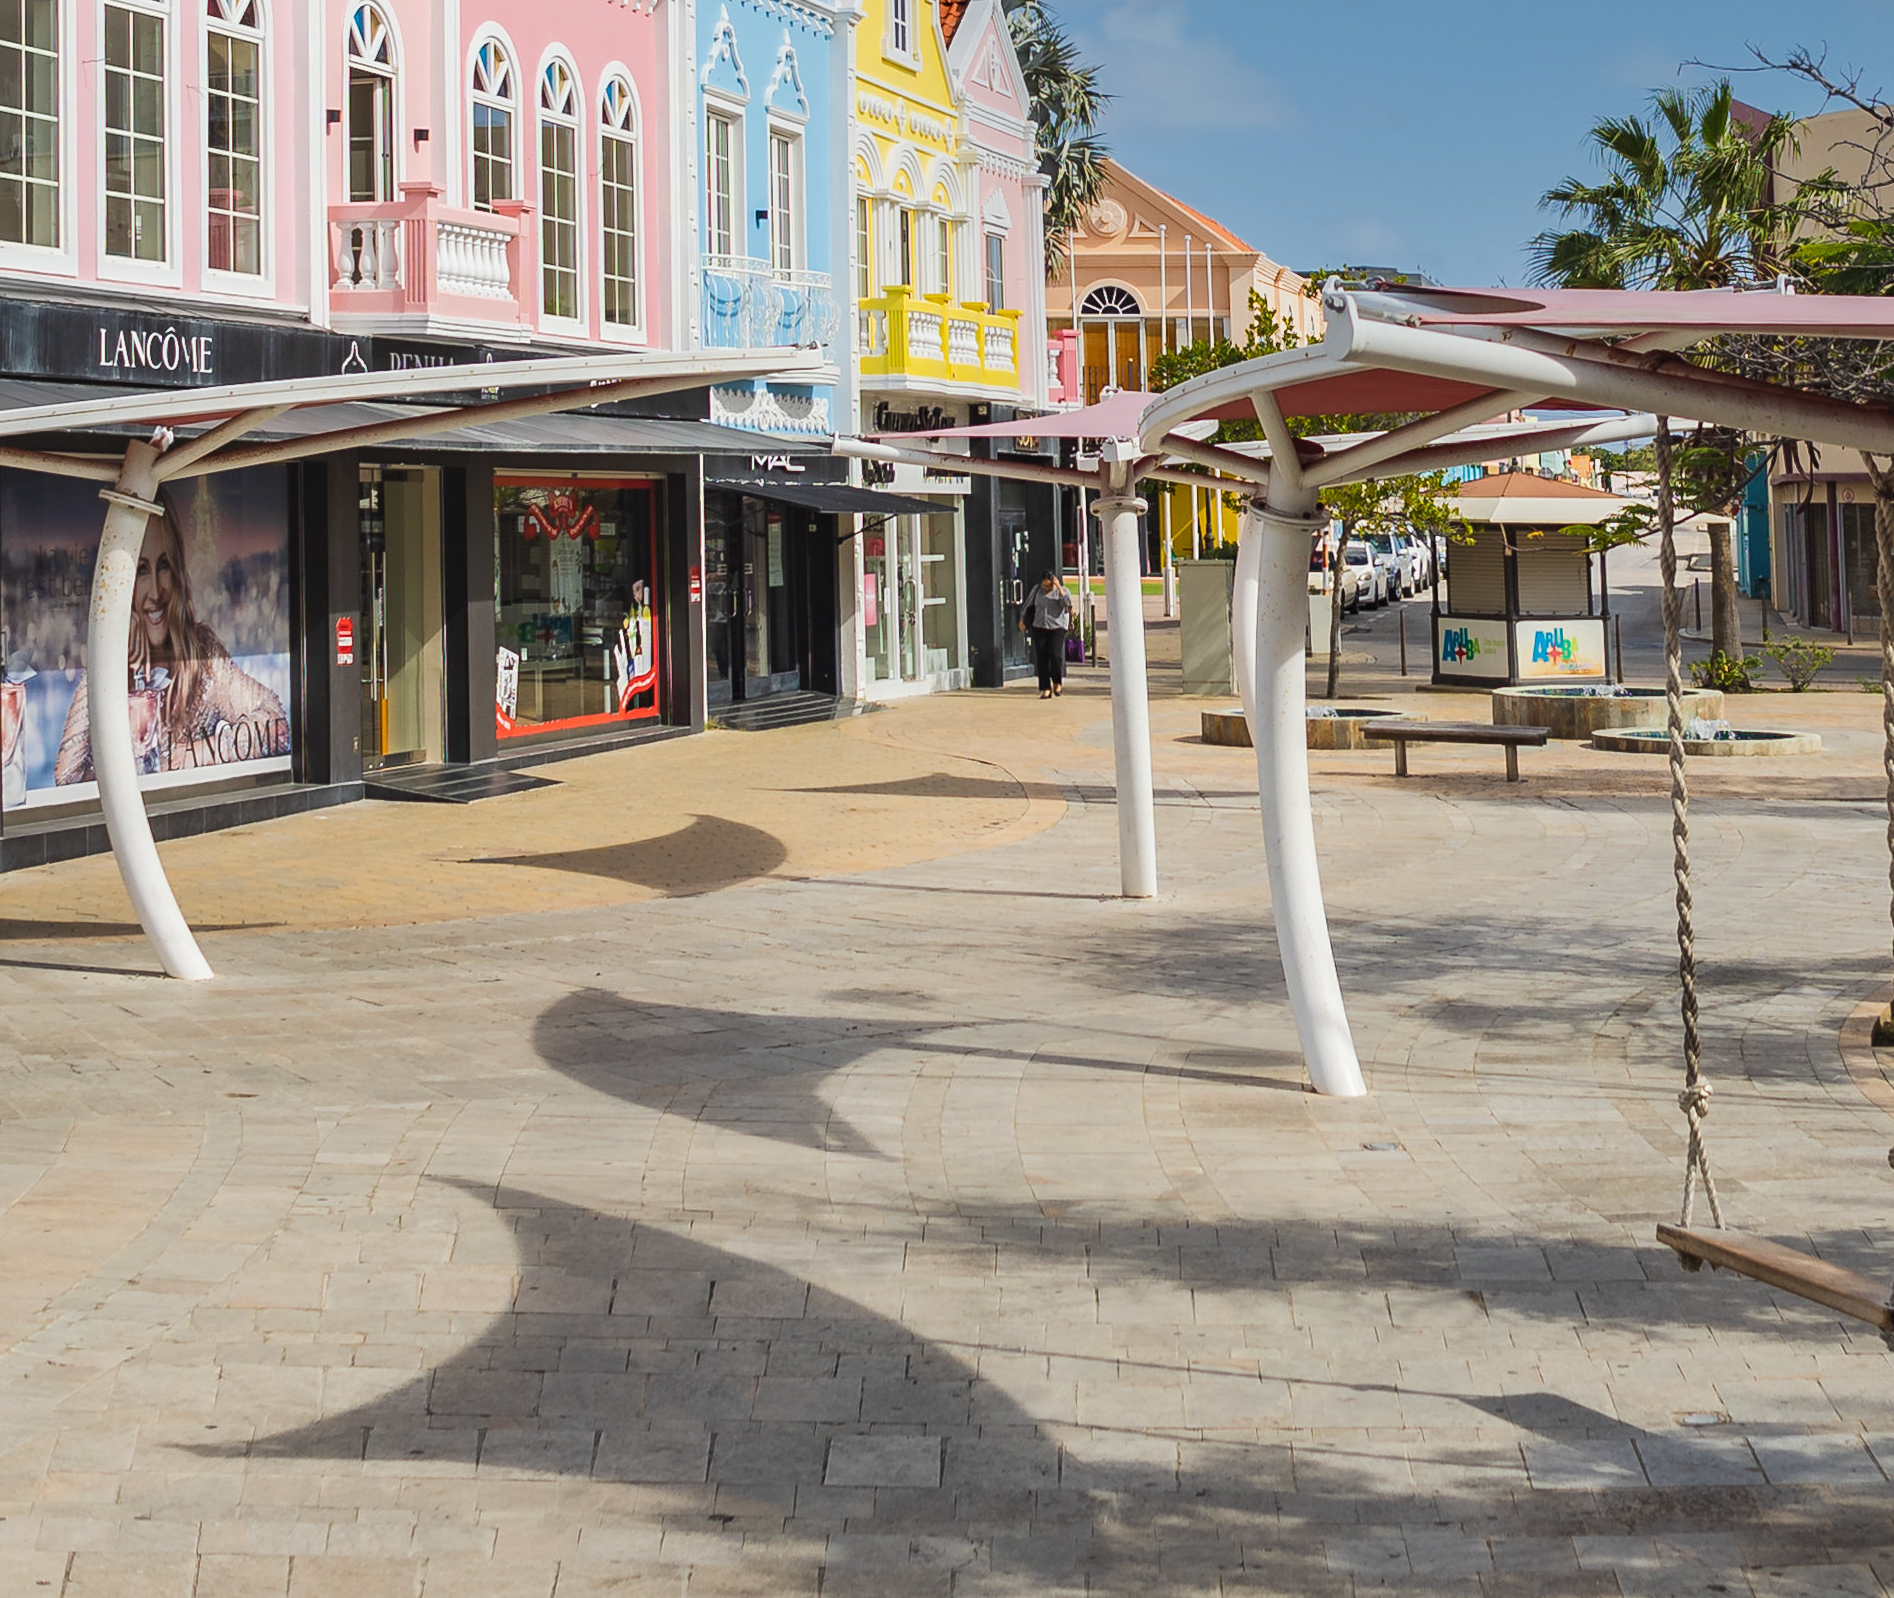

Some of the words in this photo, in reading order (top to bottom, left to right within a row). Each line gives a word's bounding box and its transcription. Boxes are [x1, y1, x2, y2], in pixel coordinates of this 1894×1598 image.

[99, 326, 213, 374] LANCÔME
[61, 571, 89, 597] bel
[1441, 626, 1481, 662] ARUBA
[1532, 627, 1579, 663] ARUBA
[167, 713, 290, 771] LANCÔME
